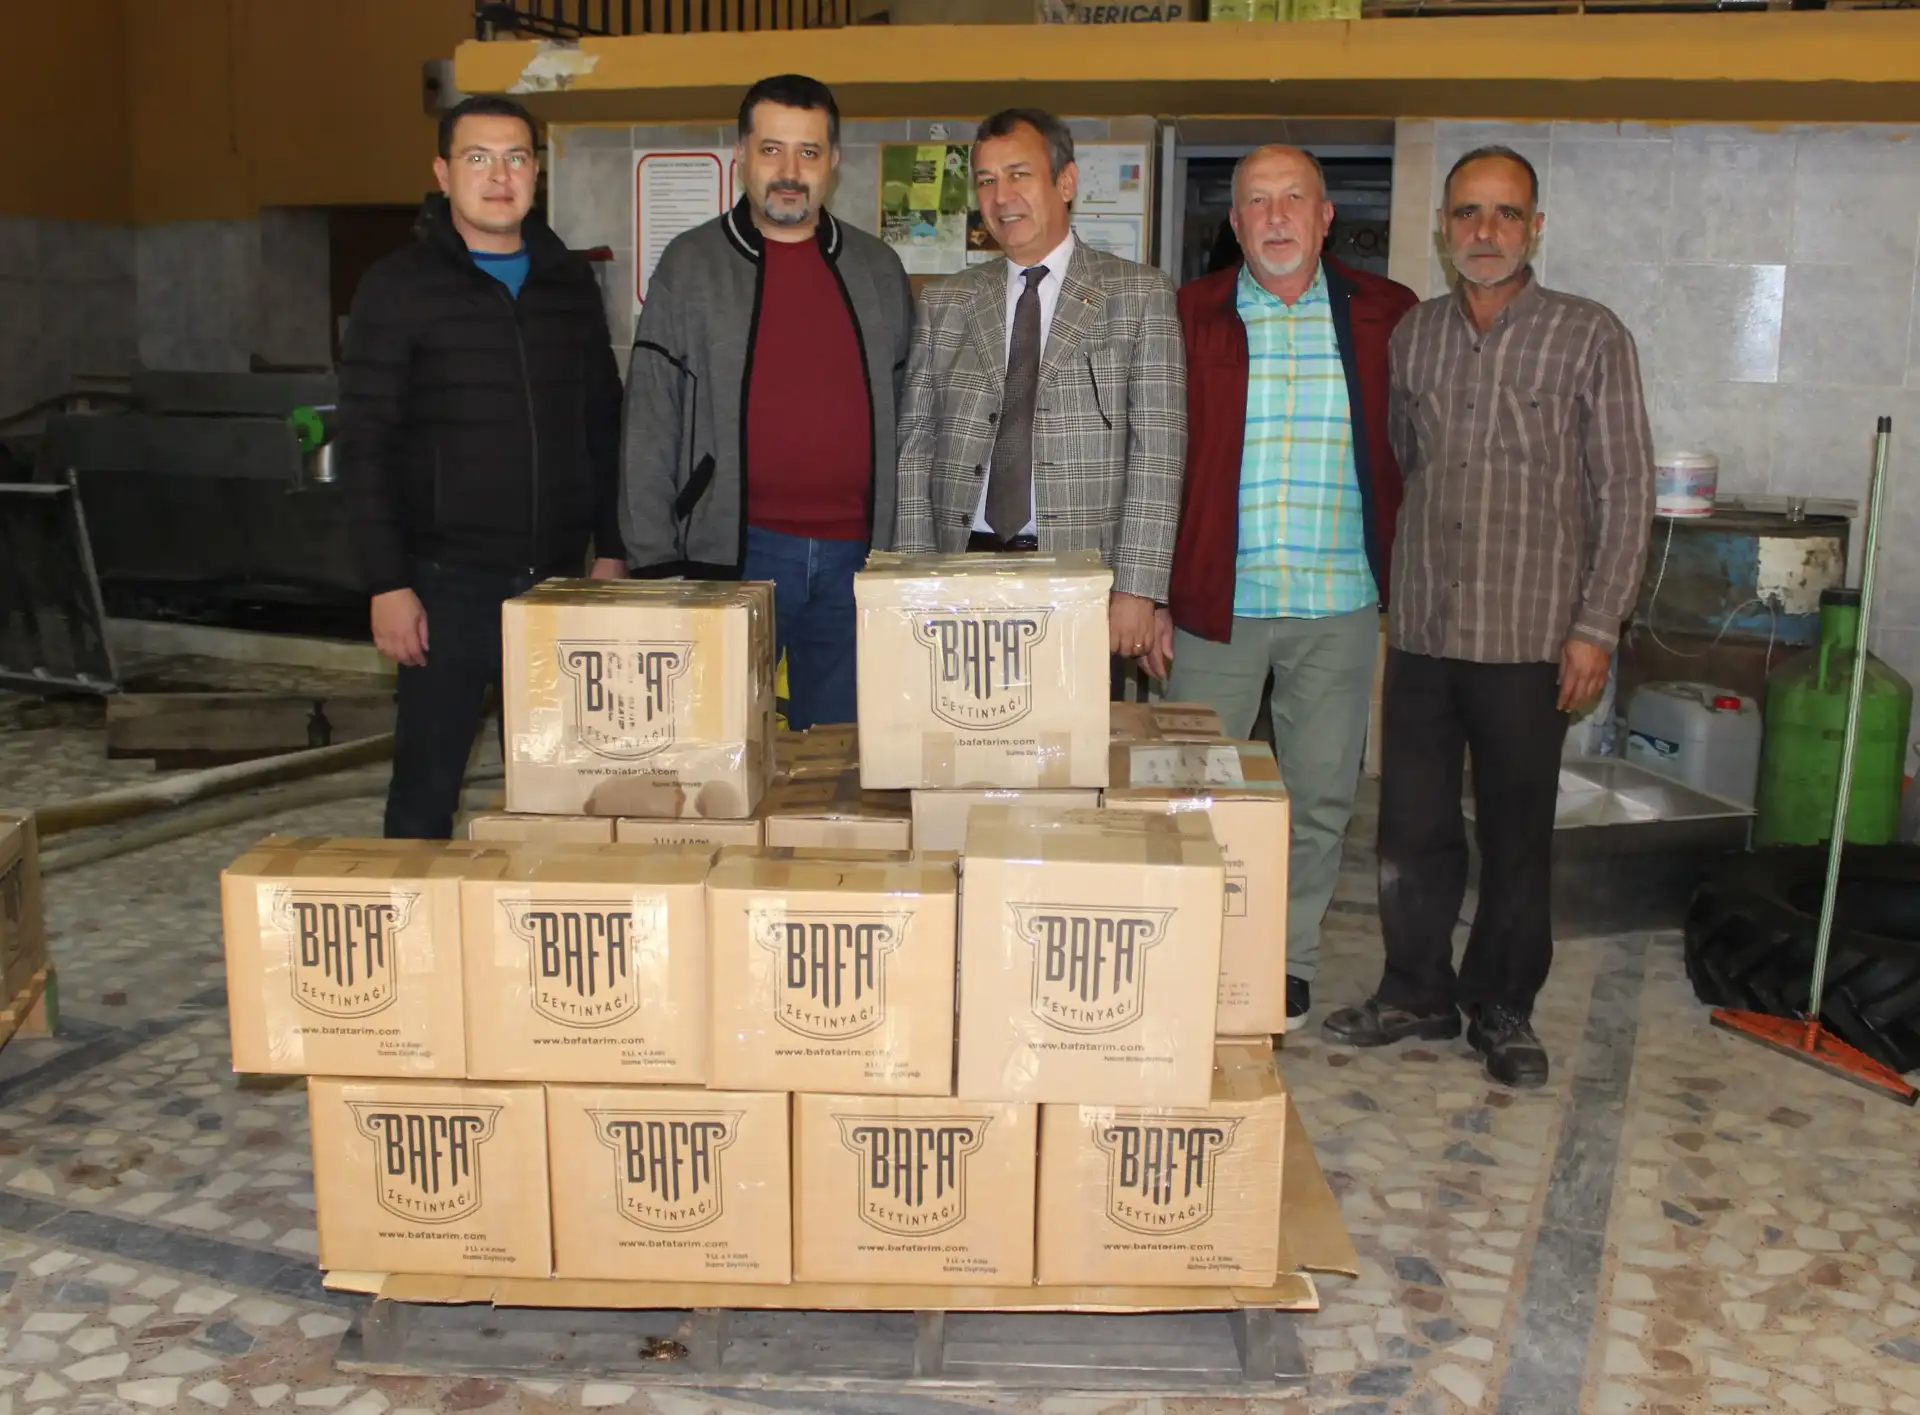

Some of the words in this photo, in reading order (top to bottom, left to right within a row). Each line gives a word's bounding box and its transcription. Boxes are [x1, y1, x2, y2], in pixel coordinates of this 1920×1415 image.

[923, 619, 1037, 700] BAFA
[287, 902, 400, 988] BAFA
[522, 912, 633, 998] BAFA
[768, 923, 893, 1010] BAFA
[1028, 915, 1155, 1003] BAFA
[367, 1113, 485, 1195] BAFA
[606, 1121, 727, 1203] BAFA
[852, 1126, 974, 1208] BAFA
[1103, 1126, 1224, 1206] BAFA
[378, 1230, 487, 1241] www.bafatarim.com
